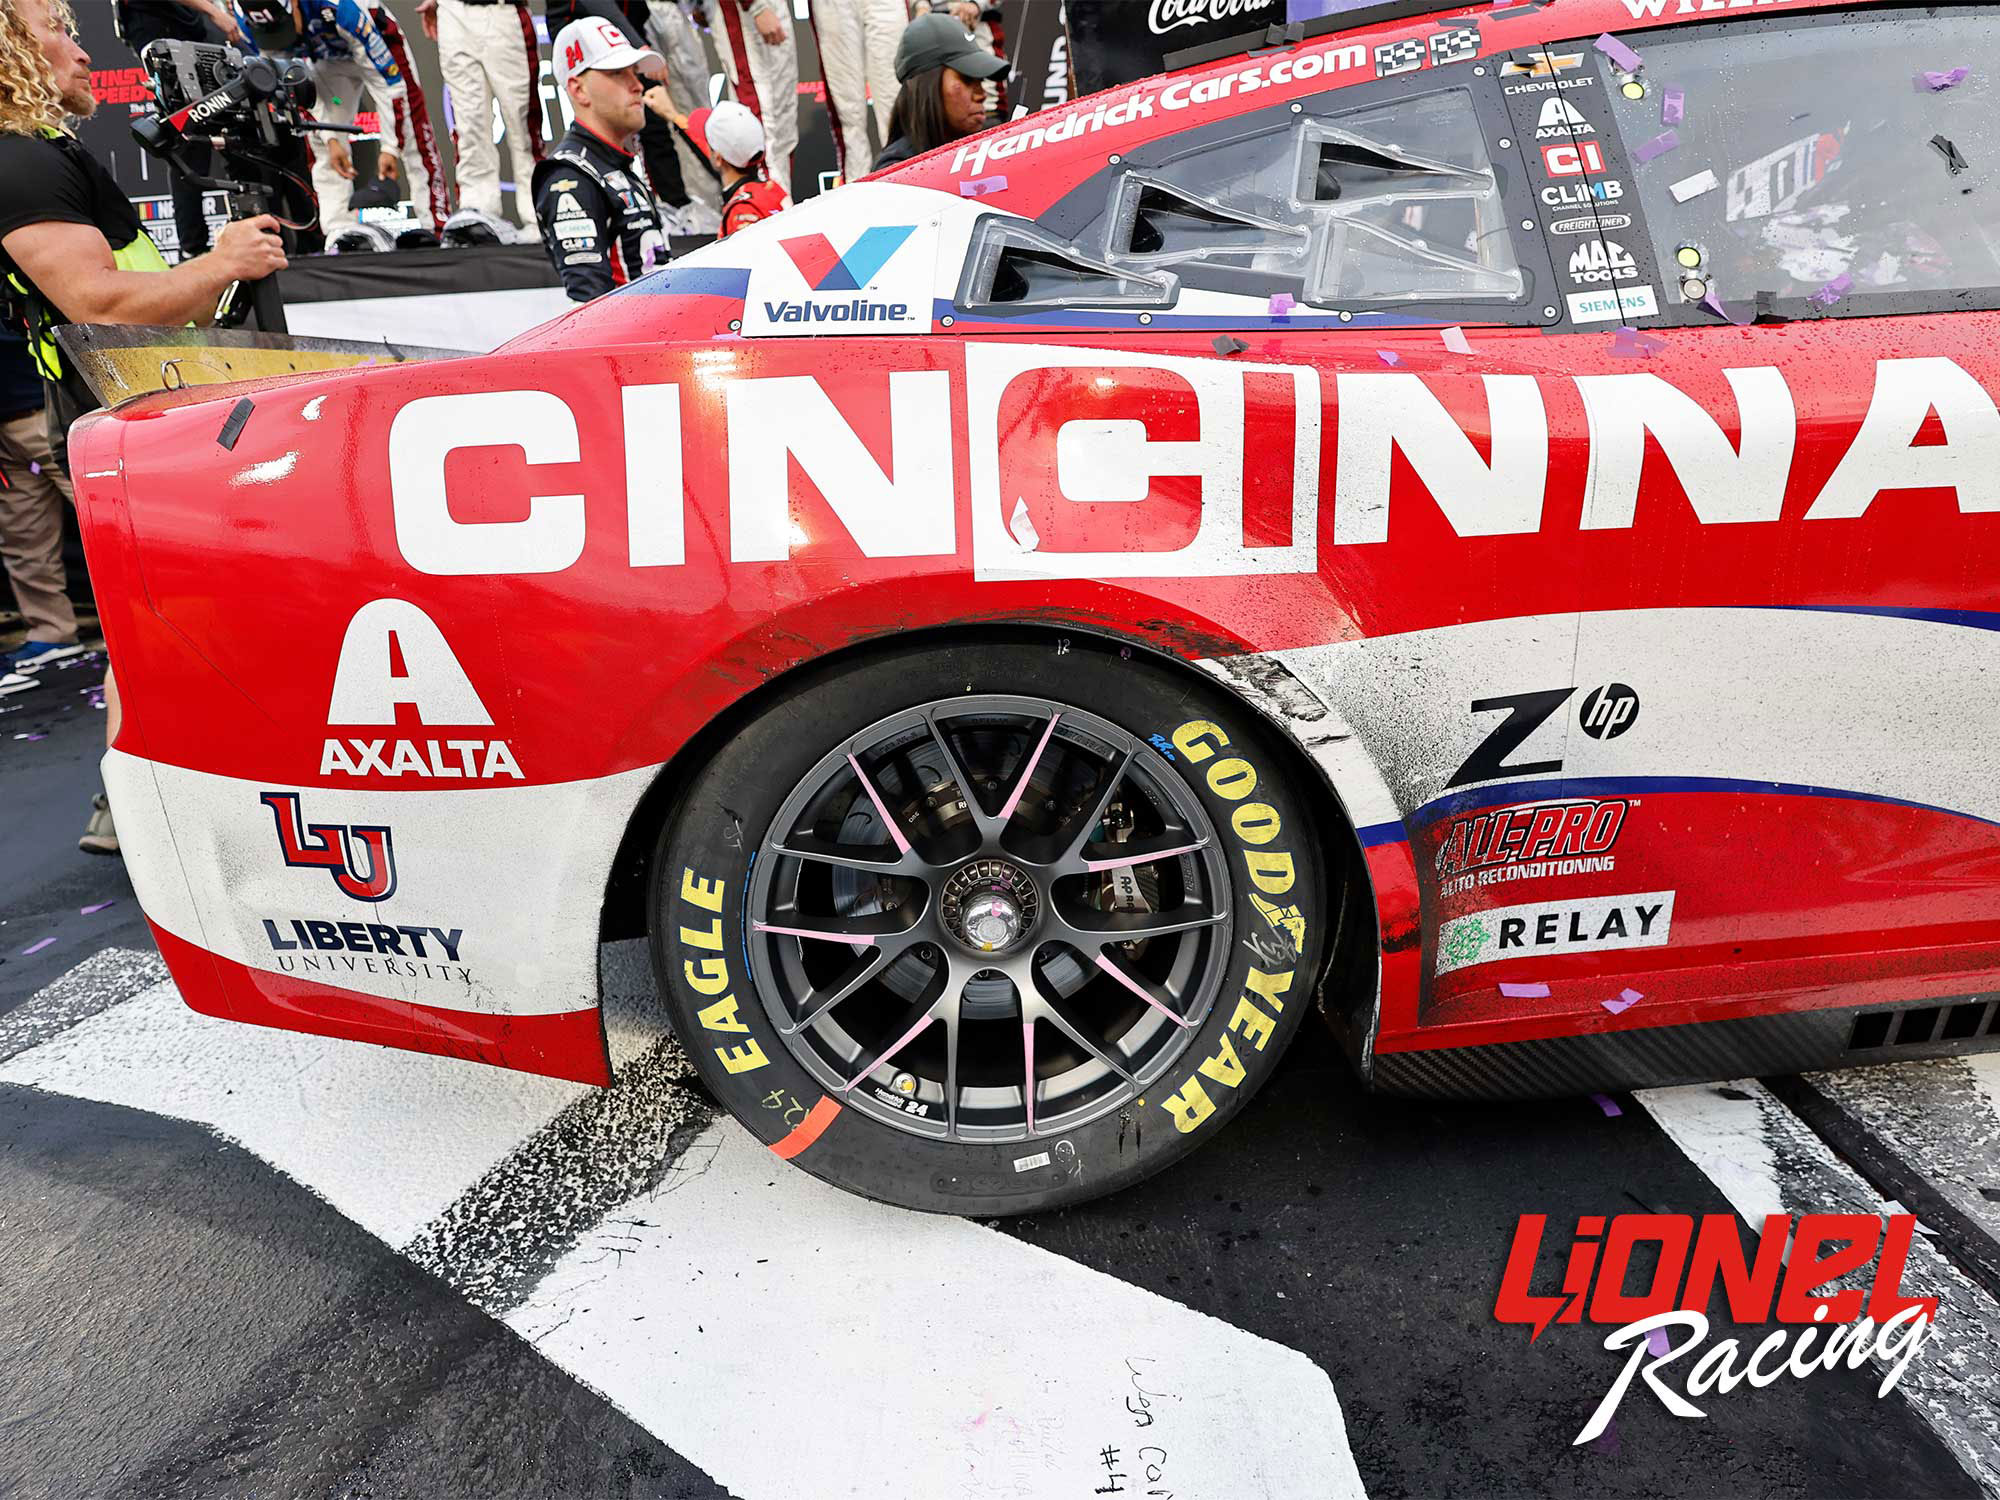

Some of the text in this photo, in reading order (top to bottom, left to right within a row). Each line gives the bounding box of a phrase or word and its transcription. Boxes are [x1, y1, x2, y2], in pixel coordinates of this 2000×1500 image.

[1148, 0, 1272, 35] CocaCola
[565, 40, 584, 70] 24
[1504, 76, 1595, 96] CHEVROLET
[187, 91, 232, 122] RONIN
[1535, 123, 1596, 139] AXALTA
[1541, 180, 1624, 205] CLIMB
[1584, 199, 1619, 209] SOUTIONS
[1569, 240, 1637, 272] MAC
[1570, 266, 1639, 284] TOOLS
[764, 300, 908, 323] Valvoline
[1579, 295, 1647, 313] SIEMENS
[319, 739, 527, 779] AXALTA
[1478, 856, 1615, 887] RECONDITIONING
[262, 919, 464, 962] LIBERTY
[1161, 719, 1296, 1134] GOODYEAR
[1498, 904, 1664, 949] RELAY
[276, 955, 473, 985] UNIVERSITY
[680, 867, 771, 1075] EAGLE
[905, 1100, 929, 1117] 24
